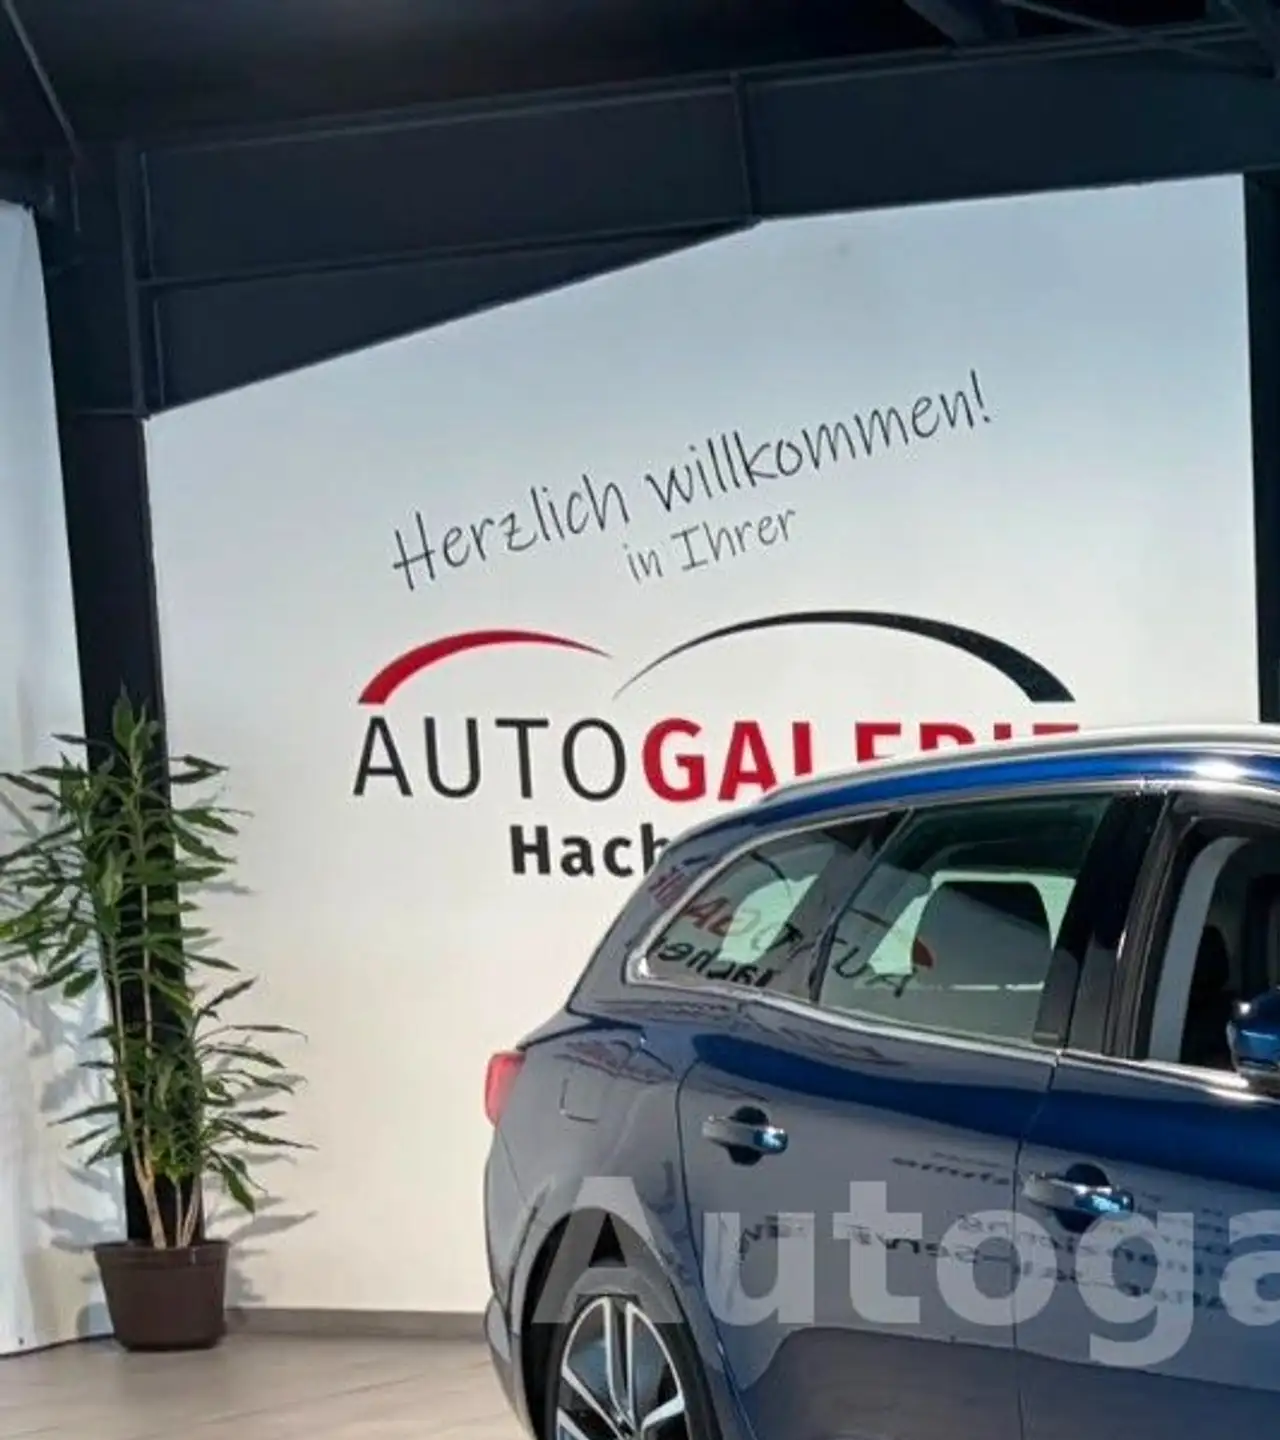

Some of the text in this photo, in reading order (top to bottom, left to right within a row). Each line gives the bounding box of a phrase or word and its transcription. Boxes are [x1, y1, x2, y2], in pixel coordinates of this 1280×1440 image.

[392, 369, 993, 590] Herzlich willkommen!
[621, 506, 797, 583] in Ihrer
[353, 715, 1080, 802] AUTOGAL
[509, 821, 671, 878] Hach
